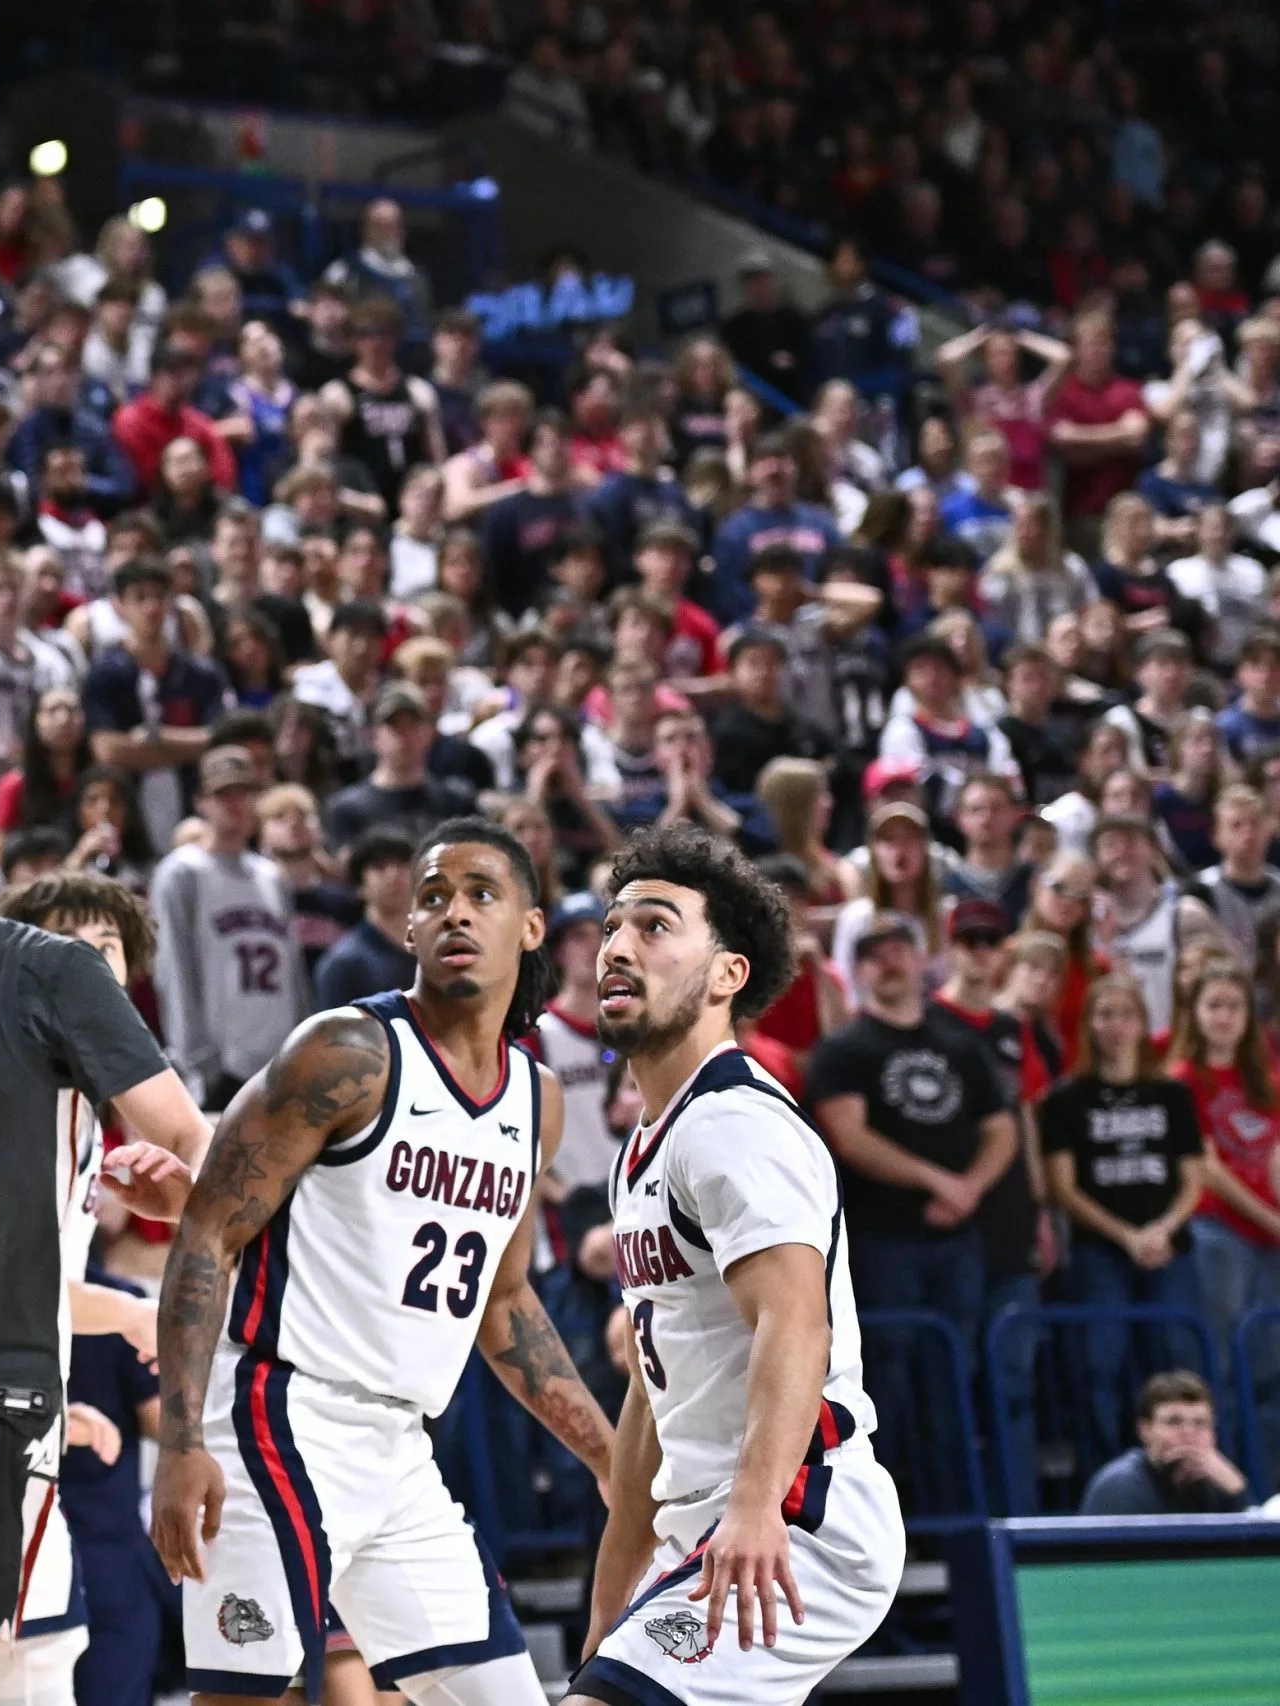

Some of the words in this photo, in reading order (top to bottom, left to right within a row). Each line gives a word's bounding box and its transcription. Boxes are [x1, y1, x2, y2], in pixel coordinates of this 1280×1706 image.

[235, 943, 281, 994] 12
[401, 1221, 487, 1319] 23
[633, 1299, 667, 1391] 3
